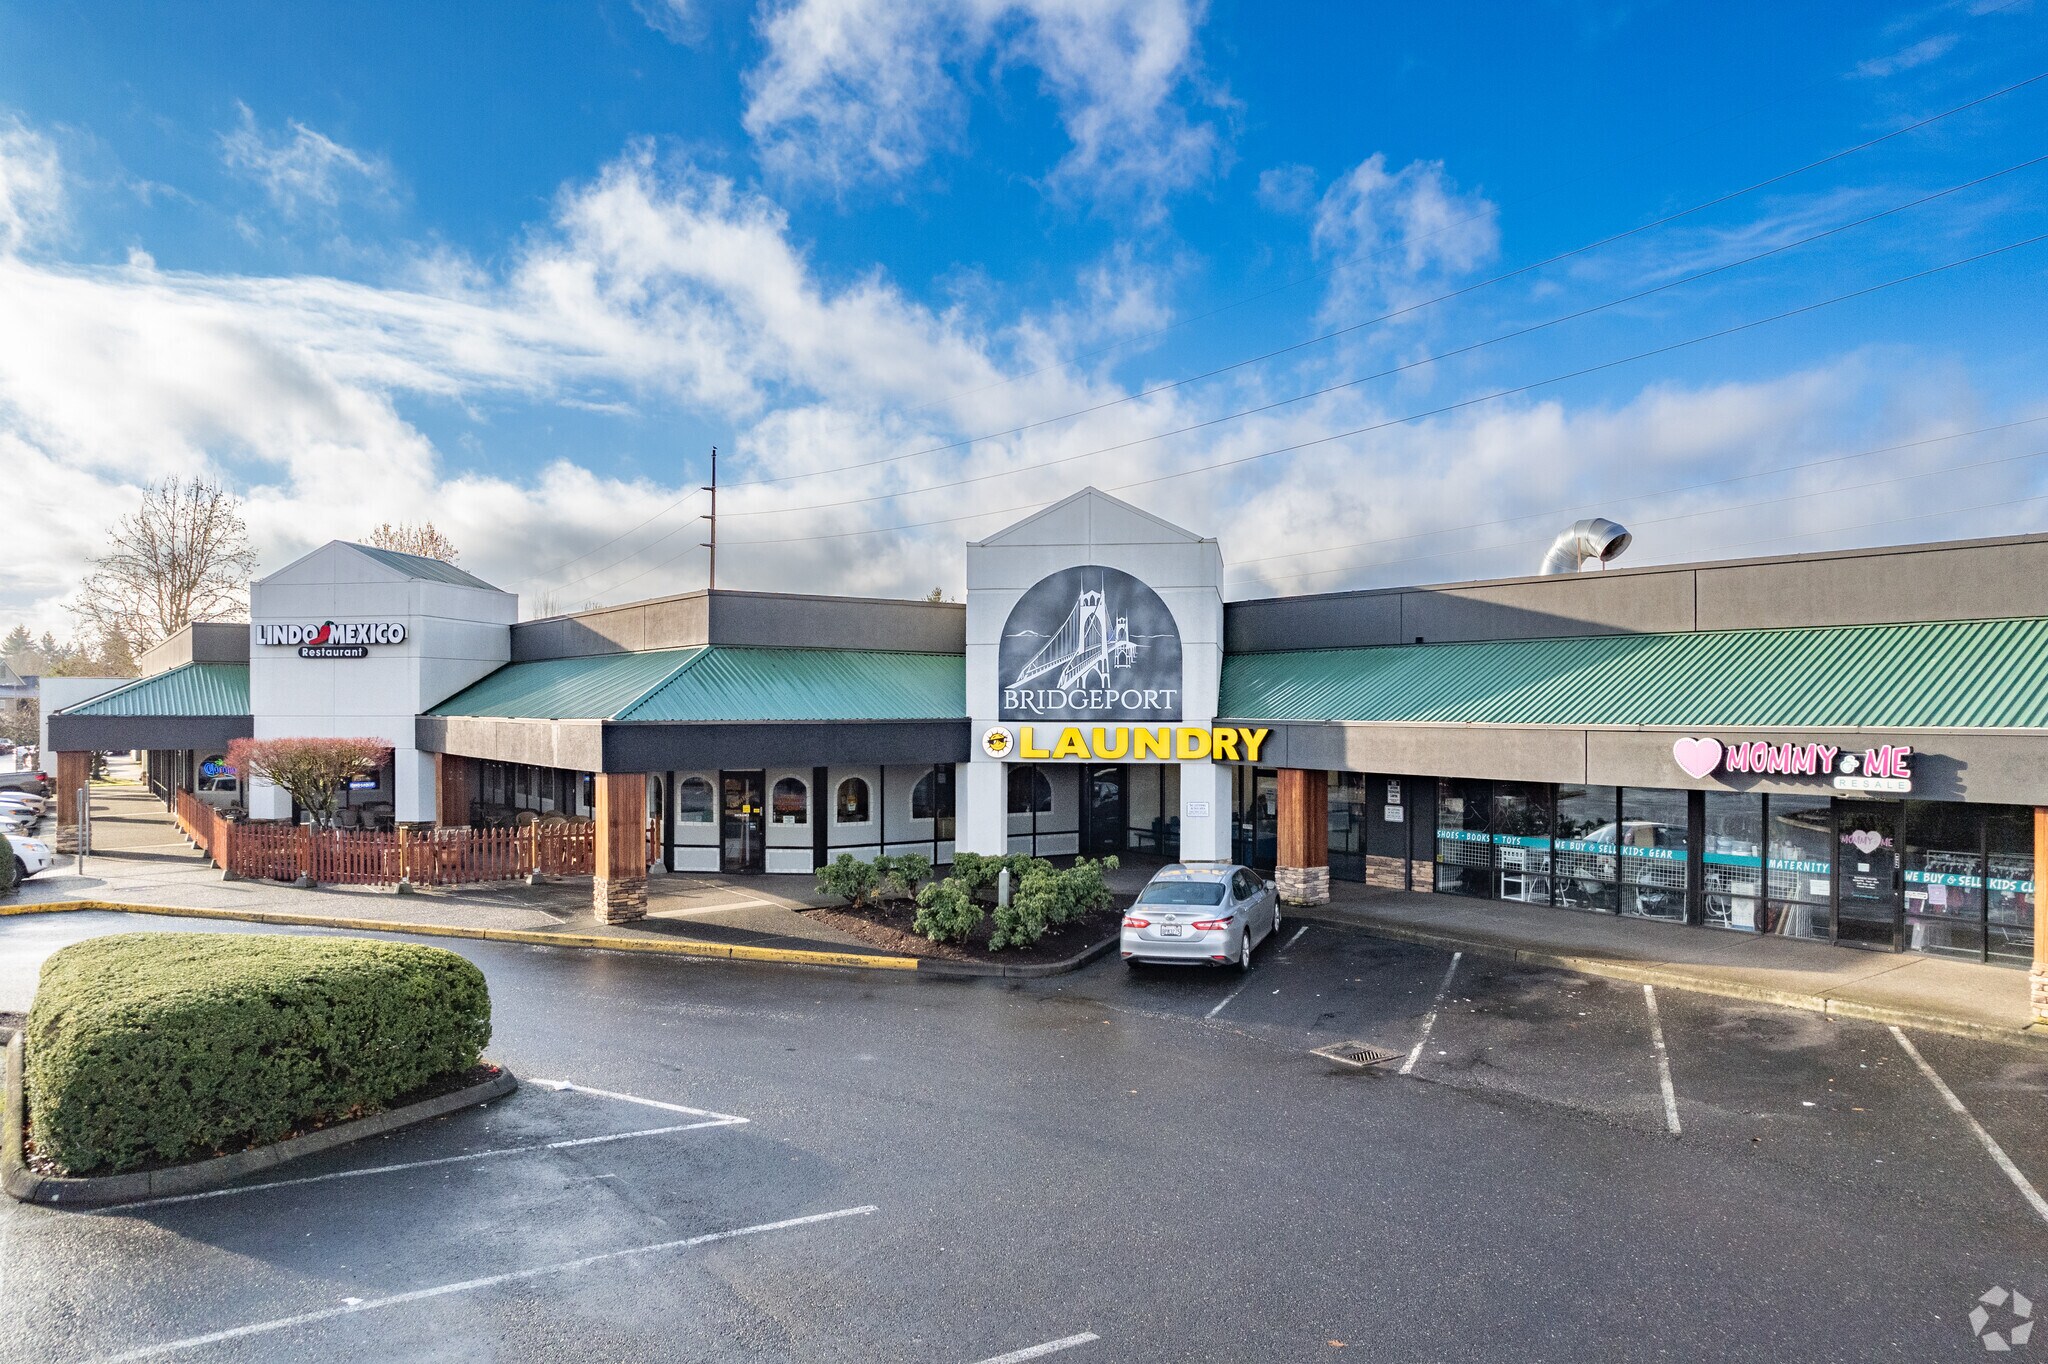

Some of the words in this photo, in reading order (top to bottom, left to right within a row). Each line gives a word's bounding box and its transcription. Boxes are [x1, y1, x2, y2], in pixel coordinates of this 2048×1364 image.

[256, 624, 319, 645] LINDO
[327, 623, 406, 645] MEXICO
[302, 647, 363, 657] Restaurant
[1003, 688, 1178, 715] BRIDGEPORT
[1019, 727, 1270, 762] LAUNDRY
[1726, 741, 1838, 775] MOMMY
[1839, 755, 1860, 774] &
[1863, 744, 1912, 778] ME
[1838, 778, 1906, 790] RESALE
[1437, 830, 1459, 840] SHOES
[1466, 833, 1490, 842] BOOKS
[1502, 836, 1521, 845] TOYS
[1554, 840, 1565, 850] WE
[1569, 841, 1586, 851] BUY
[1598, 844, 1617, 855] SELL
[1622, 846, 1644, 856] KIDS
[1648, 848, 1673, 859] GEAR
[1769, 860, 1830, 874] MATERNITY
[1904, 871, 1919, 882] WE
[1923, 872, 1945, 885] BUY
[1947, 875, 1957, 885] &
[1958, 876, 1982, 888] SELL
[1990, 878, 2017, 891] KIDS
[2020, 881, 2035, 893] CL
